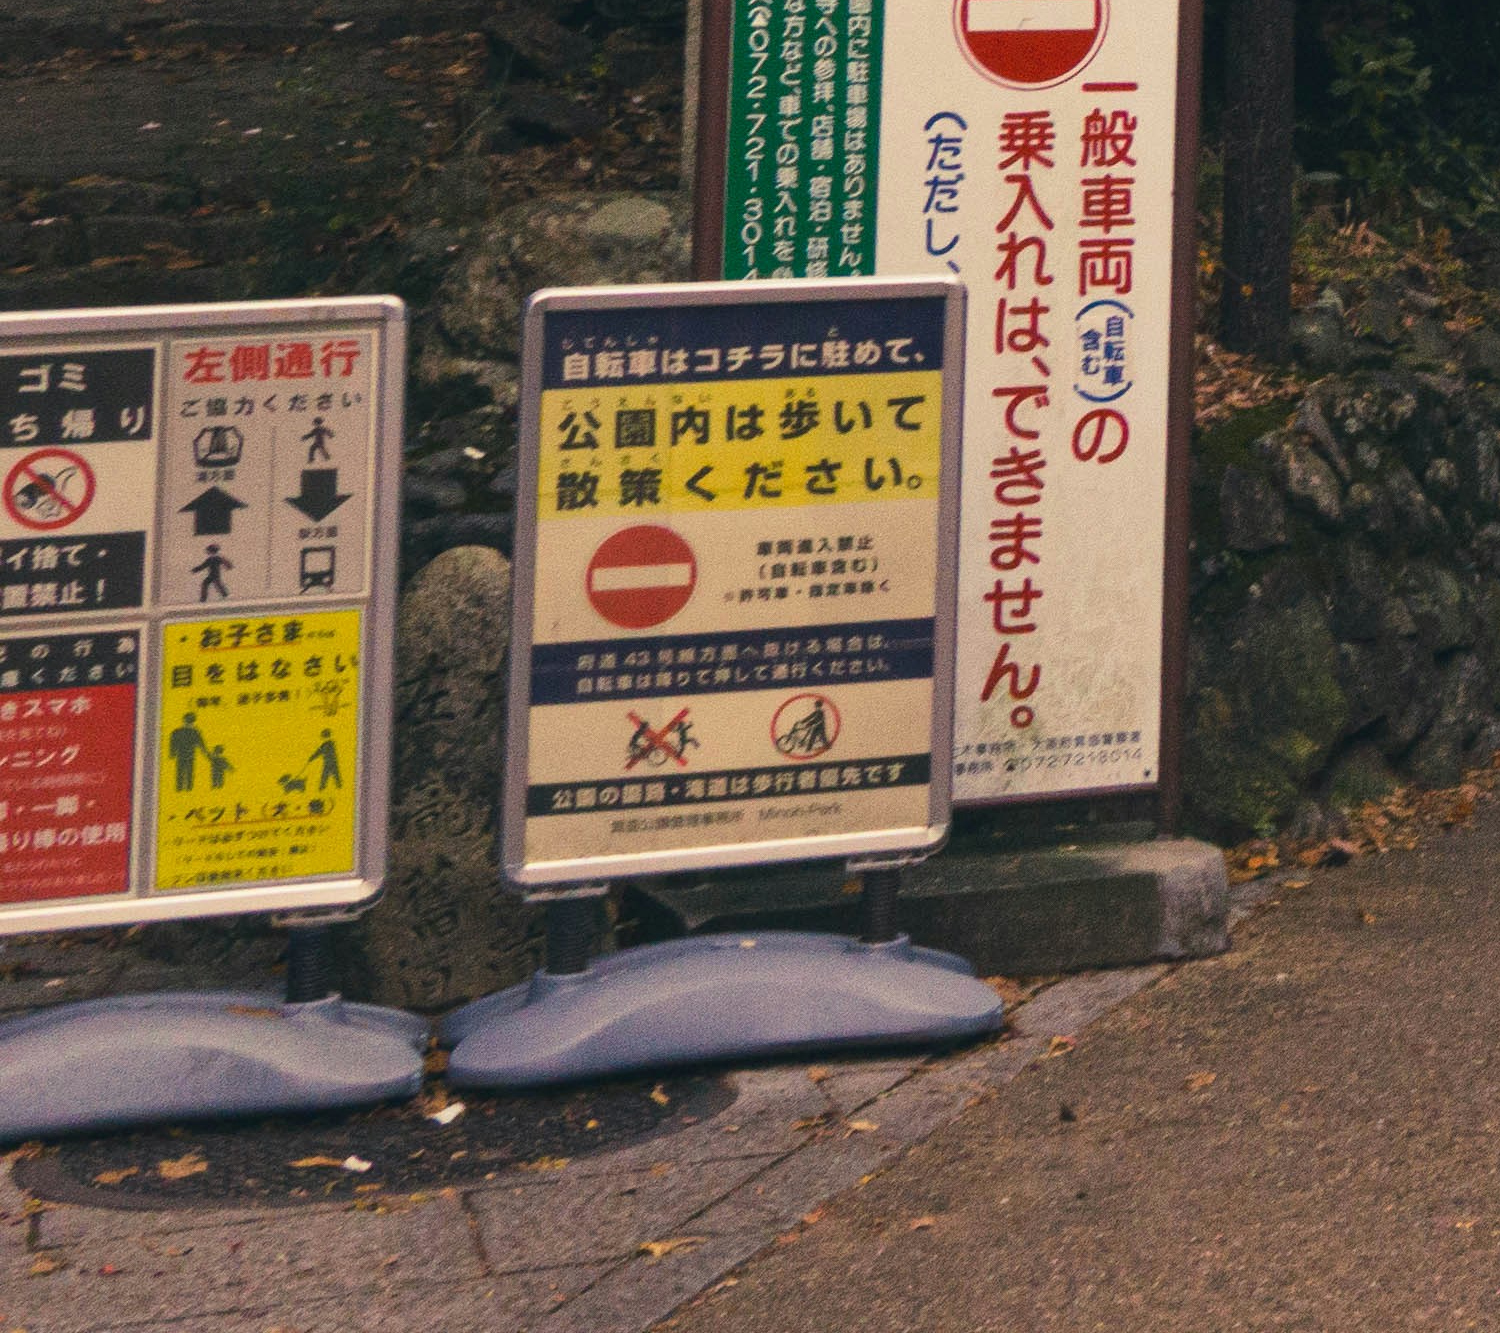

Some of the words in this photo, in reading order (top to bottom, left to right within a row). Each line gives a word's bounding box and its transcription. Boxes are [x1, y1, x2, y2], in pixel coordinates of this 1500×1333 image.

[18, 362, 88, 393] ゴミ
[182, 339, 361, 384] 左側通行
[562, 336, 926, 381] 自転車はコチラに駐めて、
[179, 392, 363, 418] ご協力ください
[557, 394, 926, 452] 公園内は歩いて
[979, 109, 1057, 730] 乗入れは、できません。
[555, 456, 923, 511] 散策ください。
